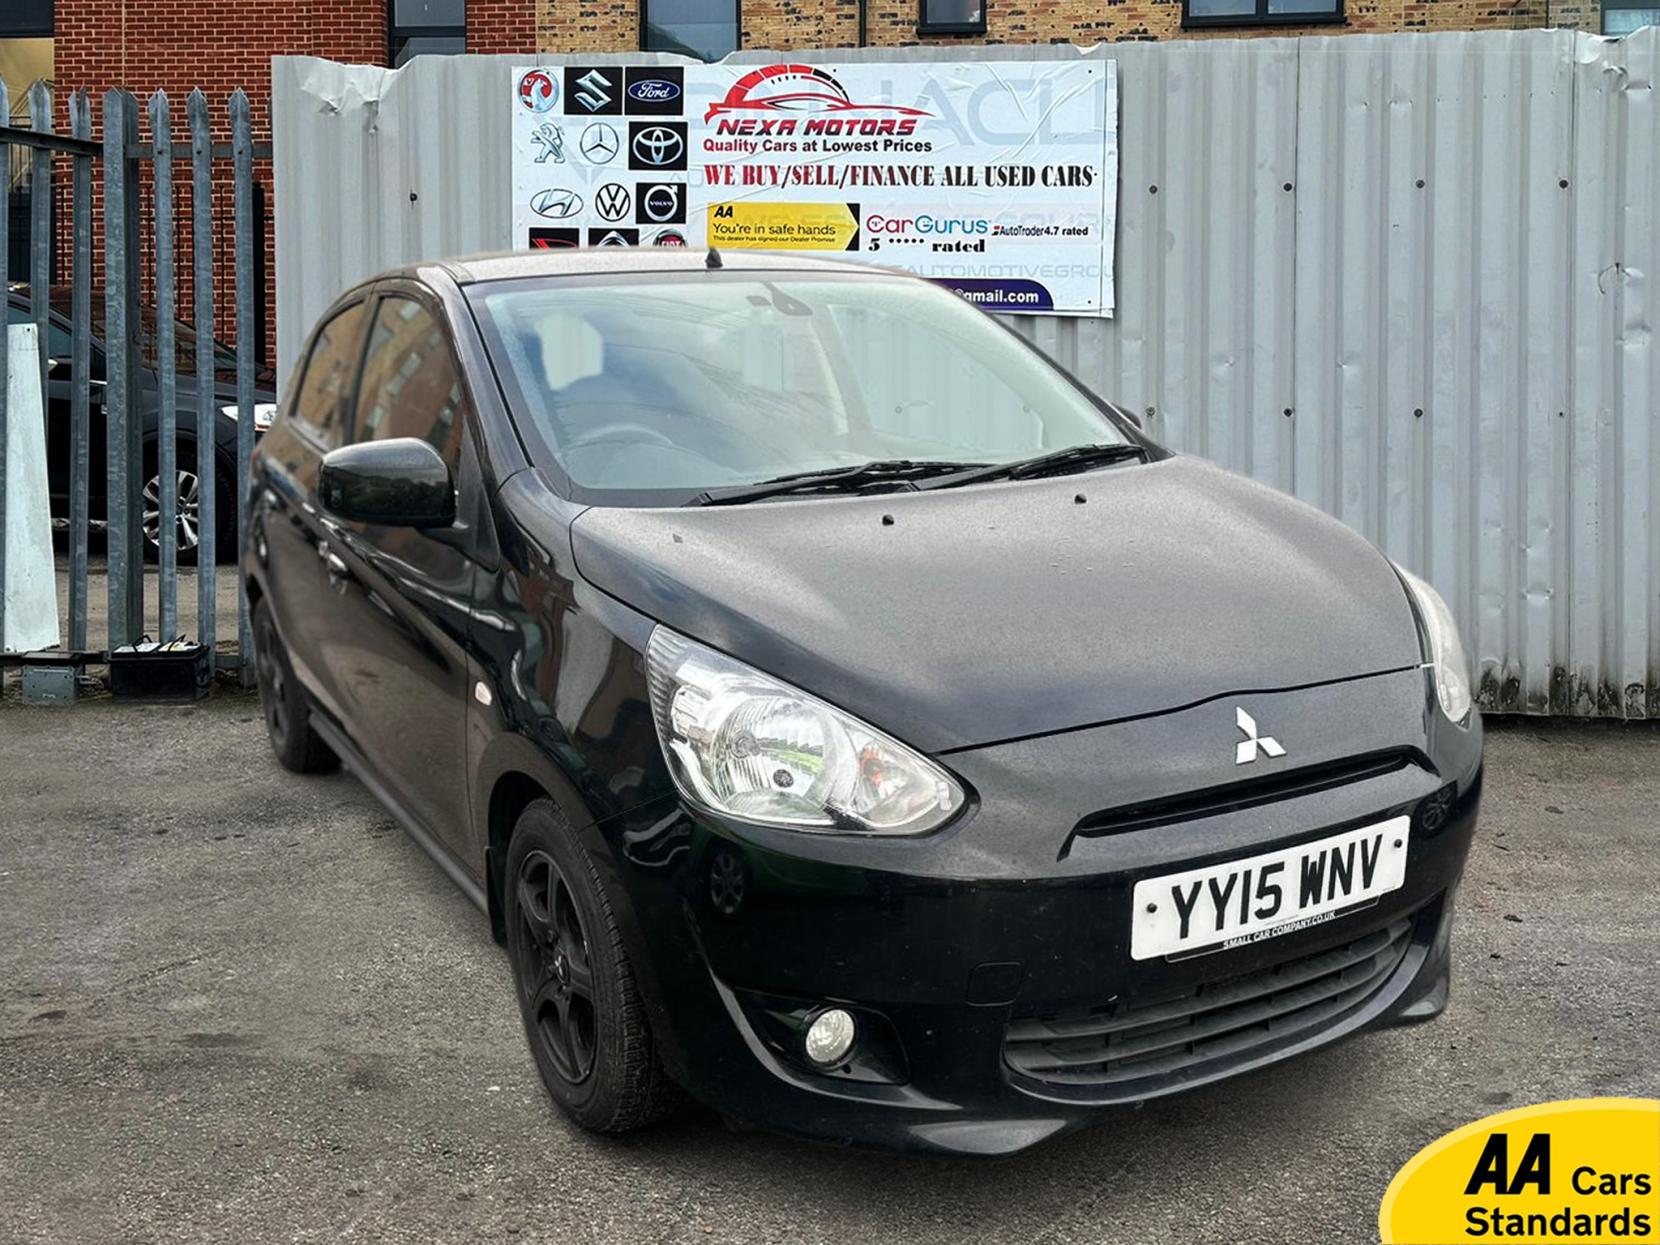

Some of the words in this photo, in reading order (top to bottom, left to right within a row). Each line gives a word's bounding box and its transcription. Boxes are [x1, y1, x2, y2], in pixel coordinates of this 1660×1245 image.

[637, 83, 670, 98] Ford
[716, 119, 798, 136] NEXA
[803, 119, 918, 136] MOTORS
[703, 139, 758, 154] Quality
[762, 139, 797, 152] Cars
[802, 140, 818, 152] at
[823, 139, 878, 152] Lowest
[883, 139, 932, 152] Prices
[704, 164, 736, 186] WE
[742, 164, 935, 190] BUY/SELL/FINANCE
[941, 165, 978, 187] ALL
[984, 165, 1036, 187] USED
[1041, 165, 1093, 187] CARS
[713, 206, 733, 218] AA
[713, 223, 751, 234] You're
[754, 223, 765, 234] in
[769, 223, 794, 235] safe
[798, 223, 836, 235] hands
[866, 214, 988, 234] CarGurus
[1062, 226, 1089, 236] rated
[868, 238, 880, 252] 5
[932, 239, 985, 252] rated
[1171, 861, 1285, 940] YY15
[1299, 834, 1383, 910] WNV
[1223, 934, 1255, 949] SMALL
[1254, 928, 1271, 942] CAR
